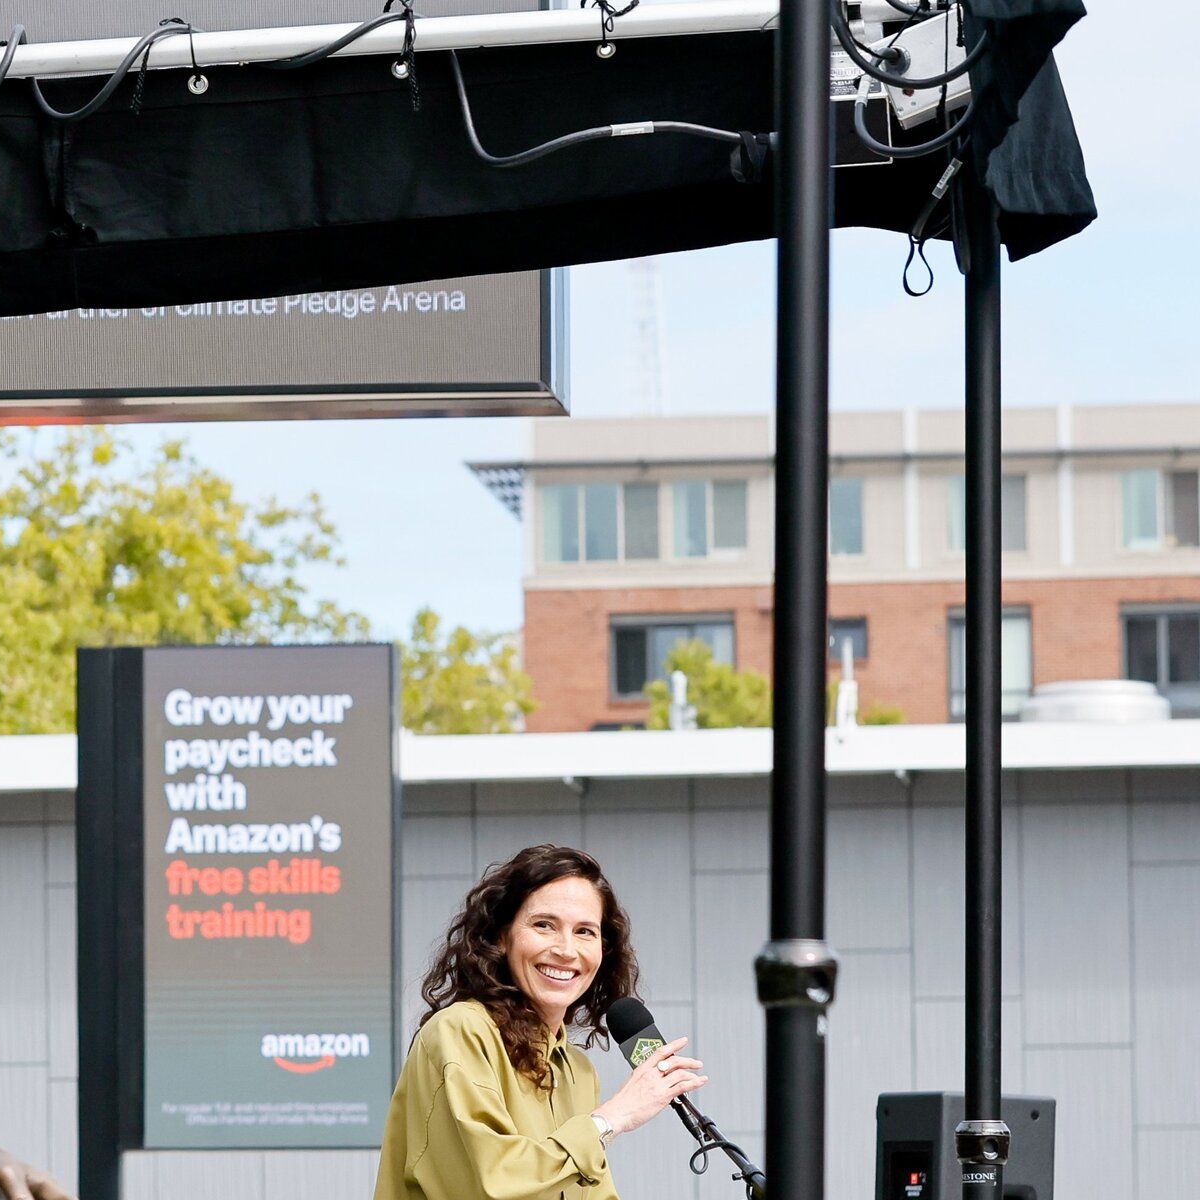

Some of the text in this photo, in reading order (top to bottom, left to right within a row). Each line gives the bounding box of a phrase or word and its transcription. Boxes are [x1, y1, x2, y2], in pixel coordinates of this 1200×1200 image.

[284, 290, 377, 319] Pledge
[382, 285, 466, 312] Arena
[164, 689, 353, 730] Grow your
[164, 730, 338, 775] paycheck
[164, 774, 247, 811] with
[164, 816, 342, 854] Amazon's
[166, 858, 342, 896] free skills
[166, 902, 313, 944] training
[261, 1033, 370, 1058] amazon
